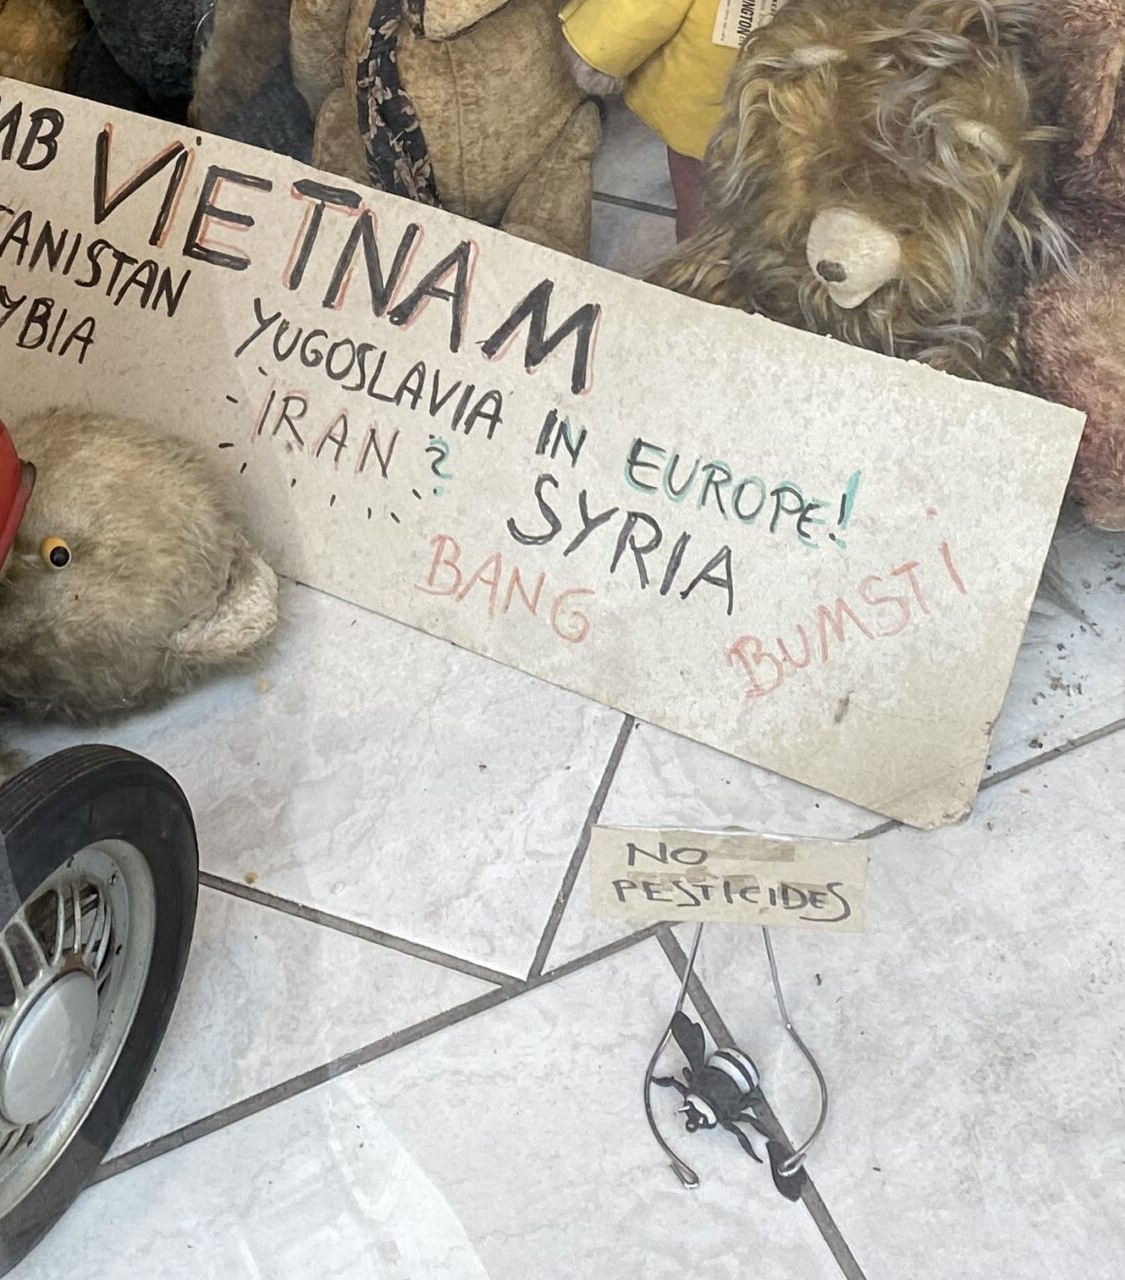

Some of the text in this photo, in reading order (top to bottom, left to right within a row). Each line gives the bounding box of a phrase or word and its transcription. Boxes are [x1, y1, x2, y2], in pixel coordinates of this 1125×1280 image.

[235, 297, 862, 550] YUGOSLAVIA IN EUROPE!
[414, 533, 596, 644] BANG
[507, 473, 735, 616] SYRIA
[612, 878, 851, 923] PESTICIDES
[627, 842, 708, 867] NO
